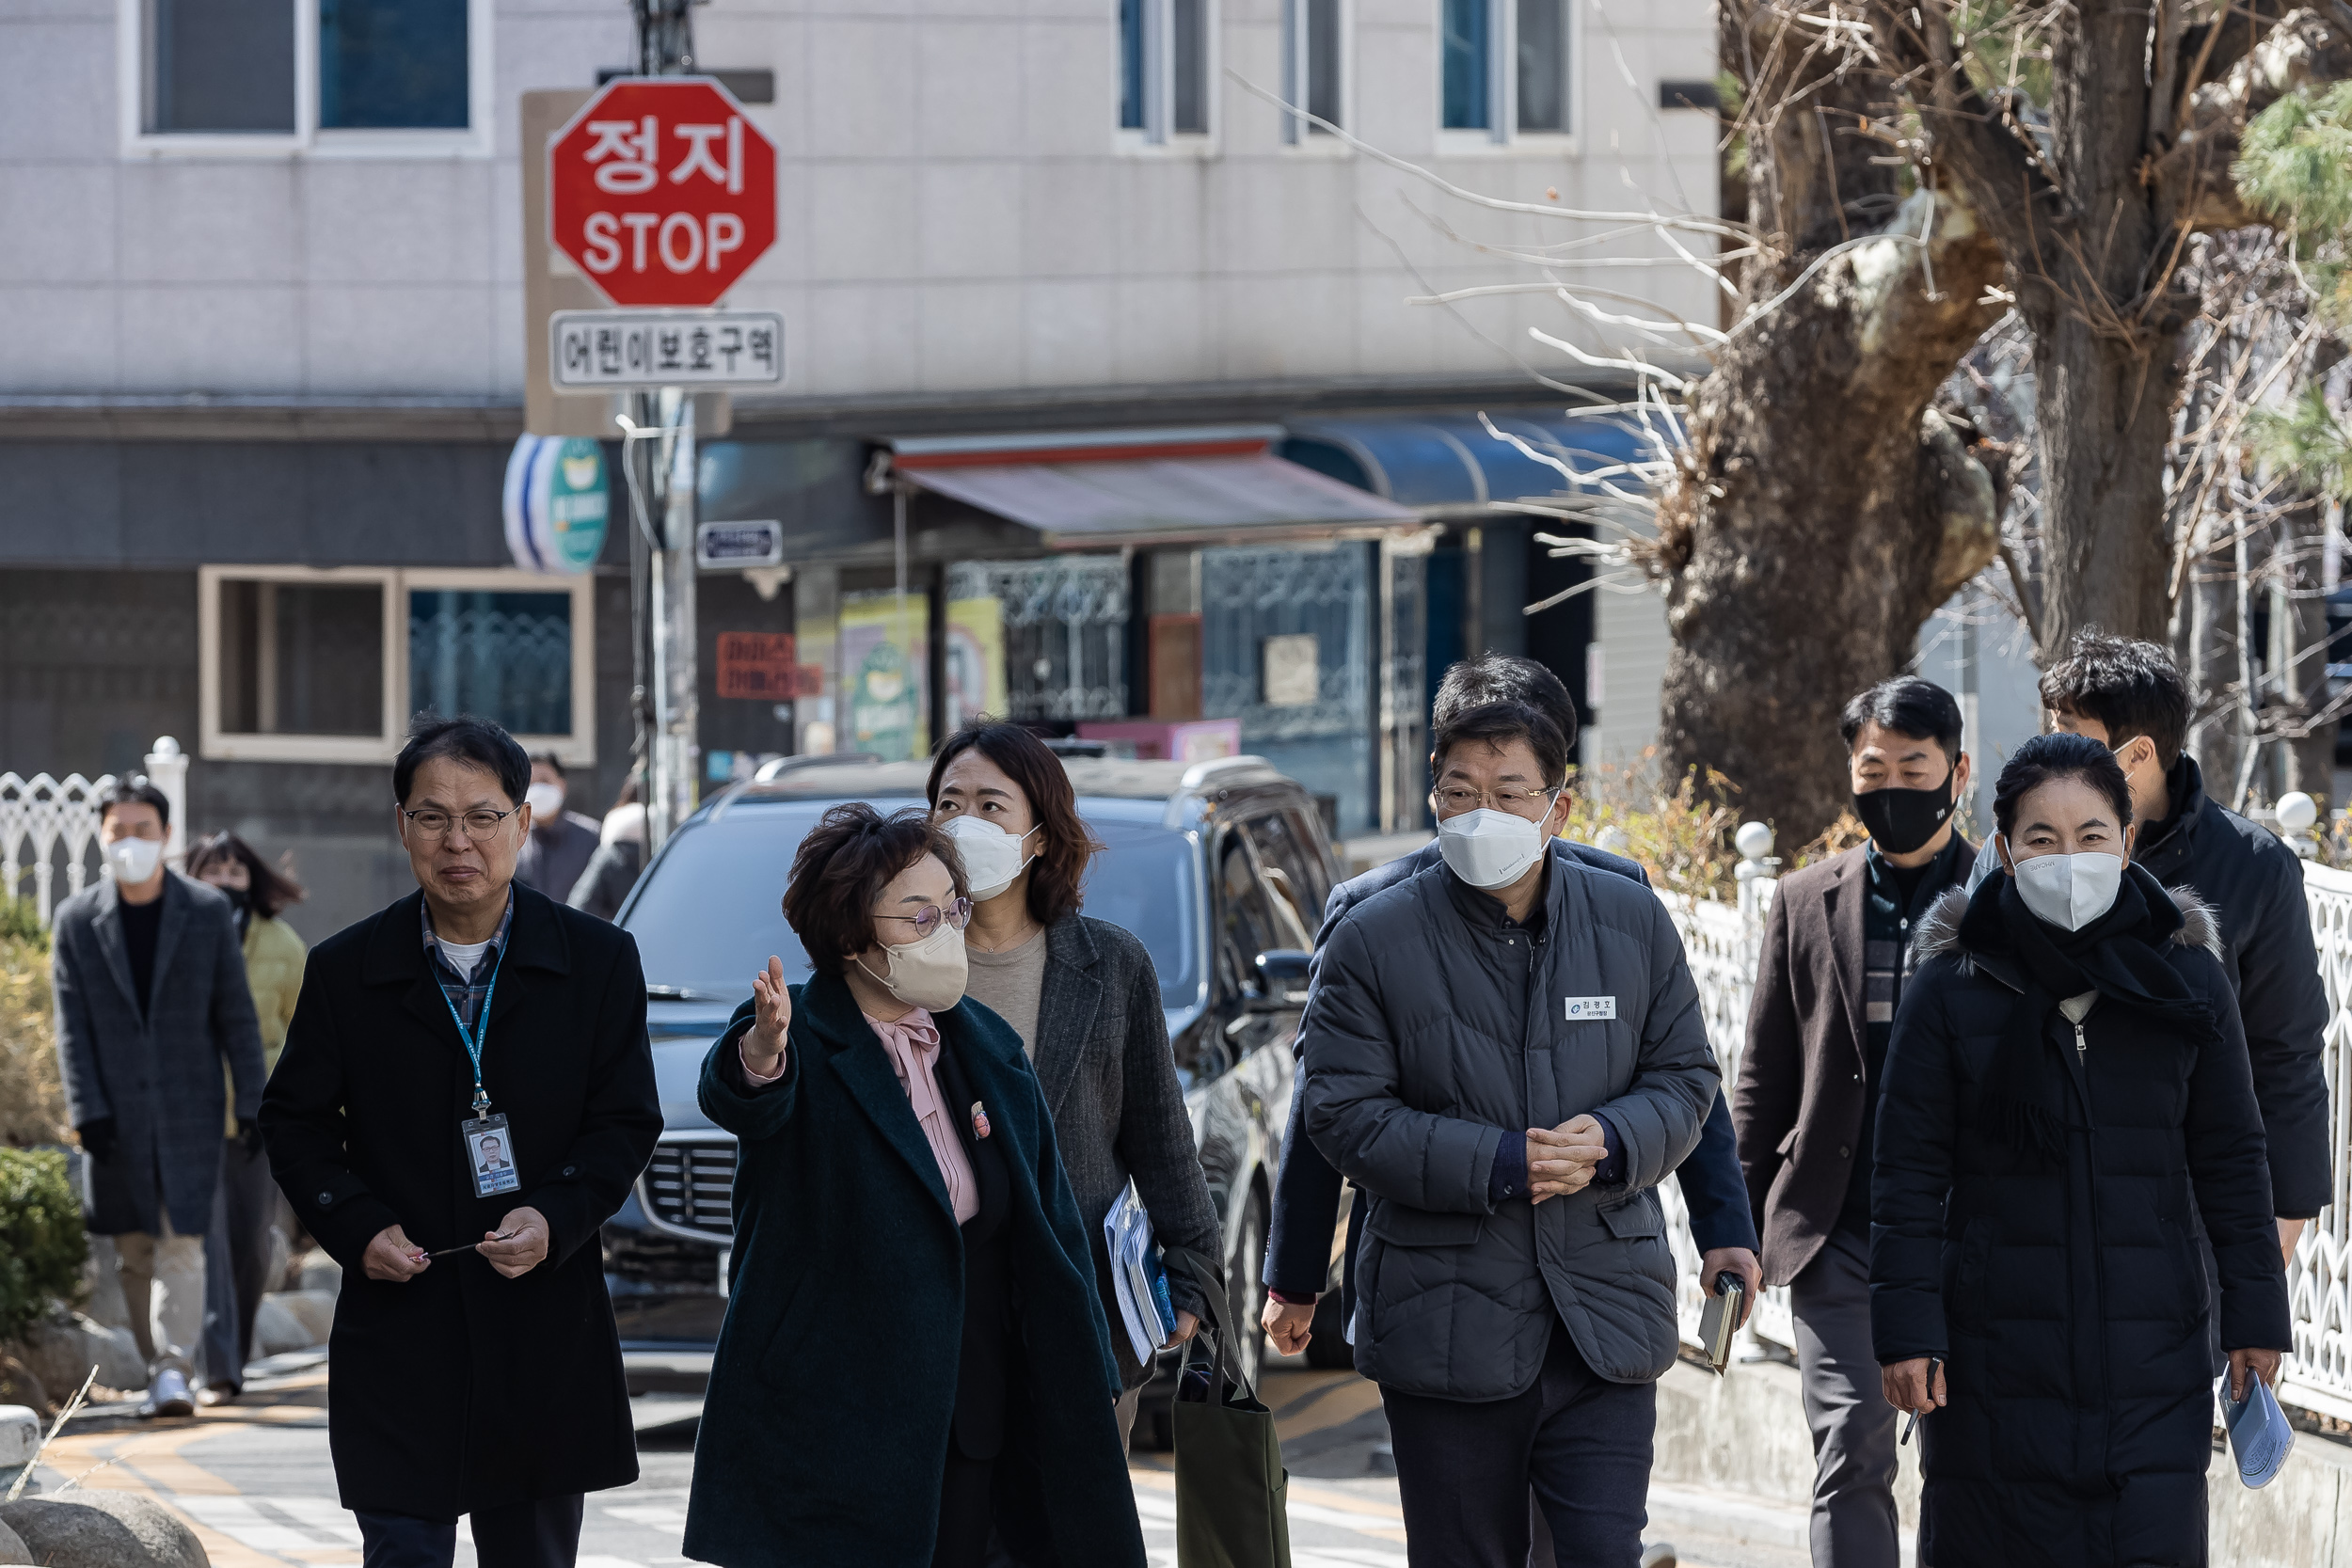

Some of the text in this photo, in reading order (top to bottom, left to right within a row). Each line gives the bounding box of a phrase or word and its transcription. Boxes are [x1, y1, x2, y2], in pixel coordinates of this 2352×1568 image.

[582, 115, 746, 195] 정지
[582, 211, 746, 275] STOP
[564, 325, 773, 374] 어린이보호구역
